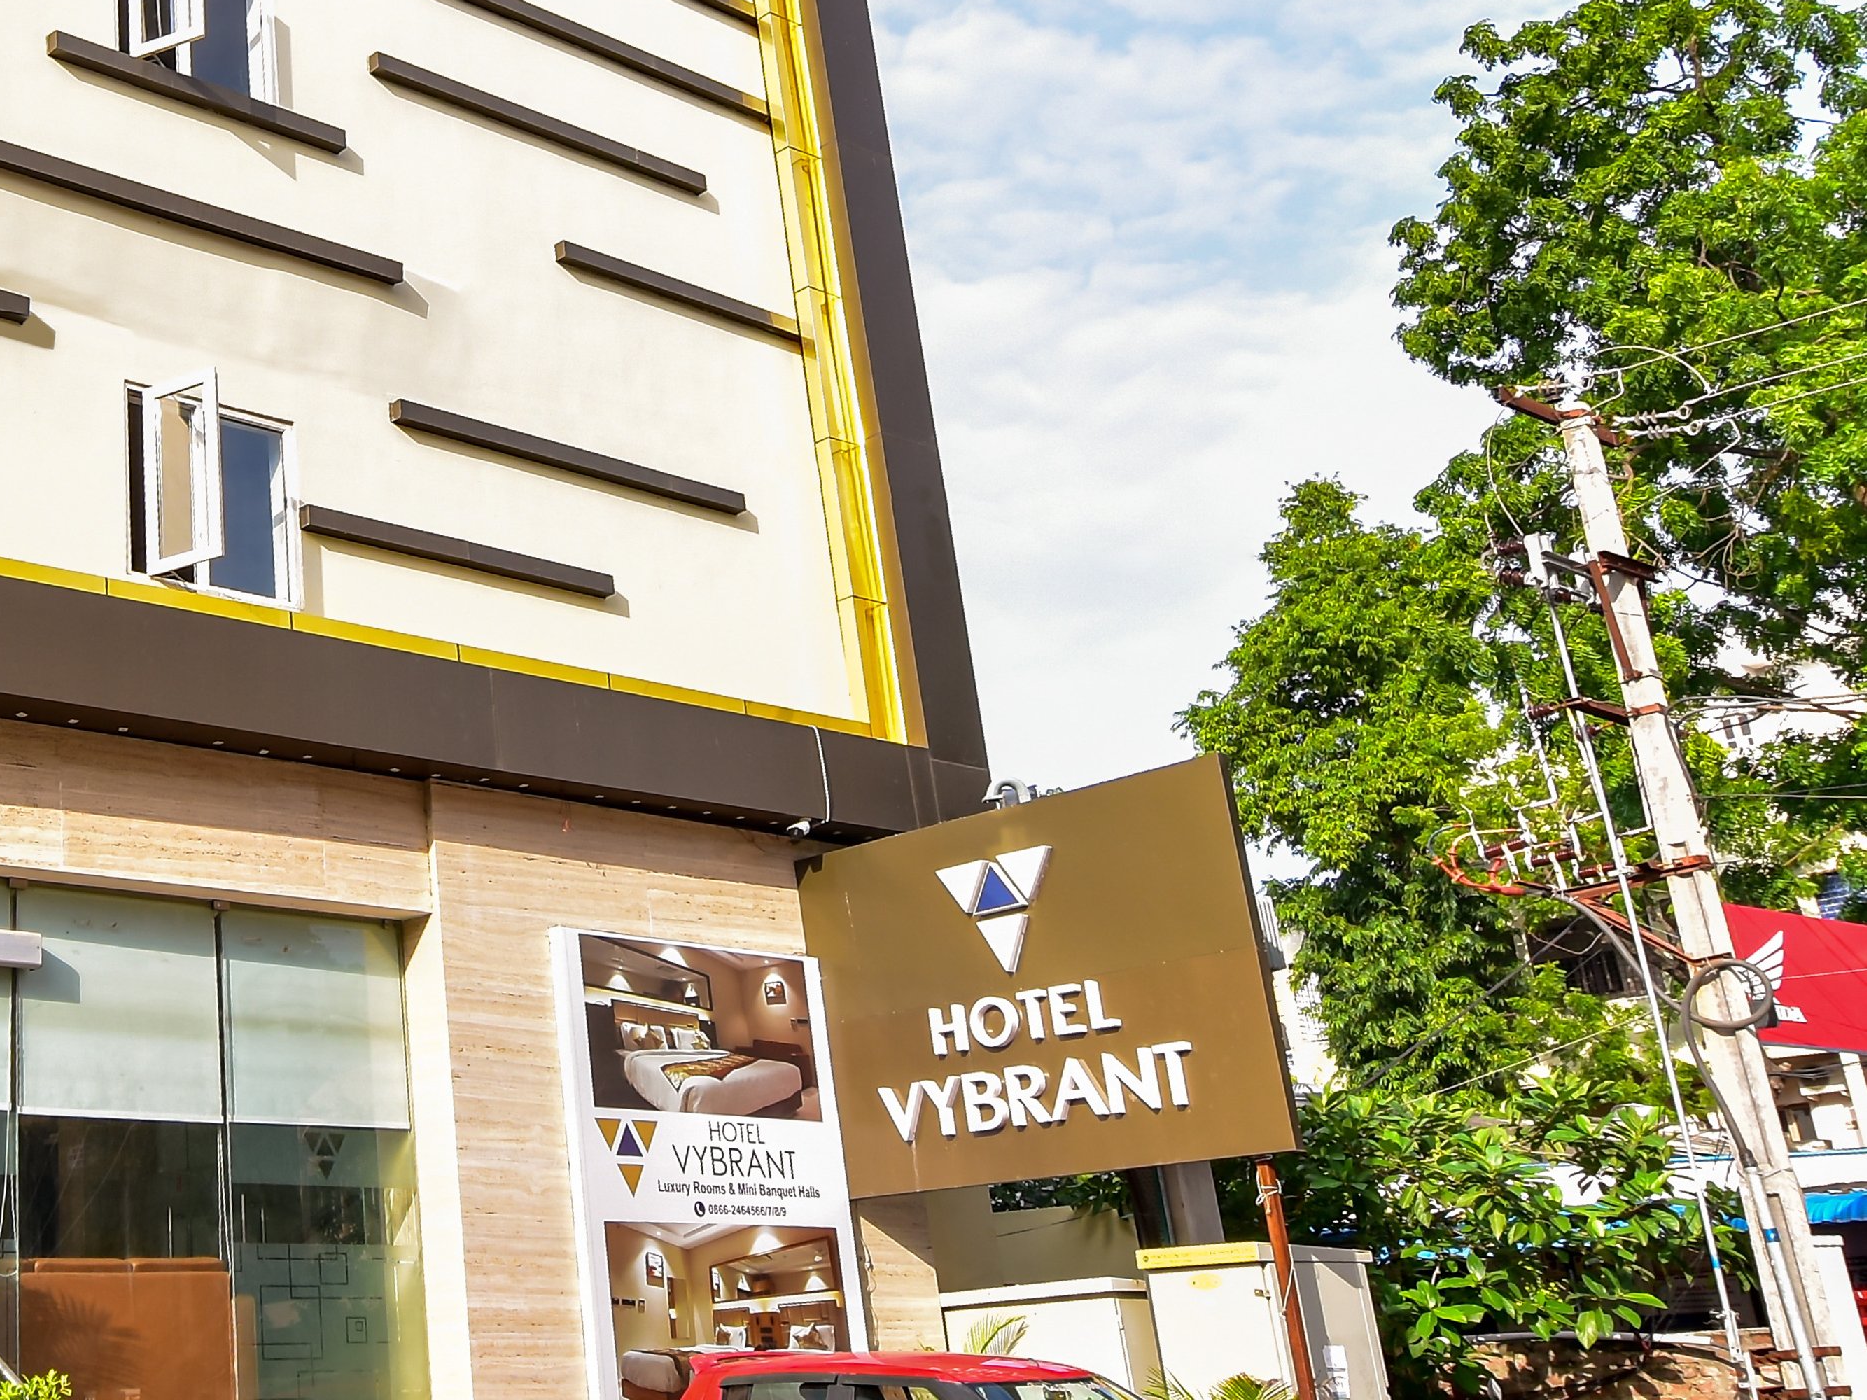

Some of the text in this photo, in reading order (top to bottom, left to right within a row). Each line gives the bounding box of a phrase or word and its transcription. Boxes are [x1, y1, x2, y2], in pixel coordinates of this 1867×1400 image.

[927, 979, 1122, 1057] HOTEL
[877, 1041, 1193, 1143] VYBRANT
[708, 1121, 765, 1144] HOTEL
[672, 1144, 795, 1179] VYBRANT
[658, 1179, 821, 1200] Luxury Rooms & Mini Banquet Halls
